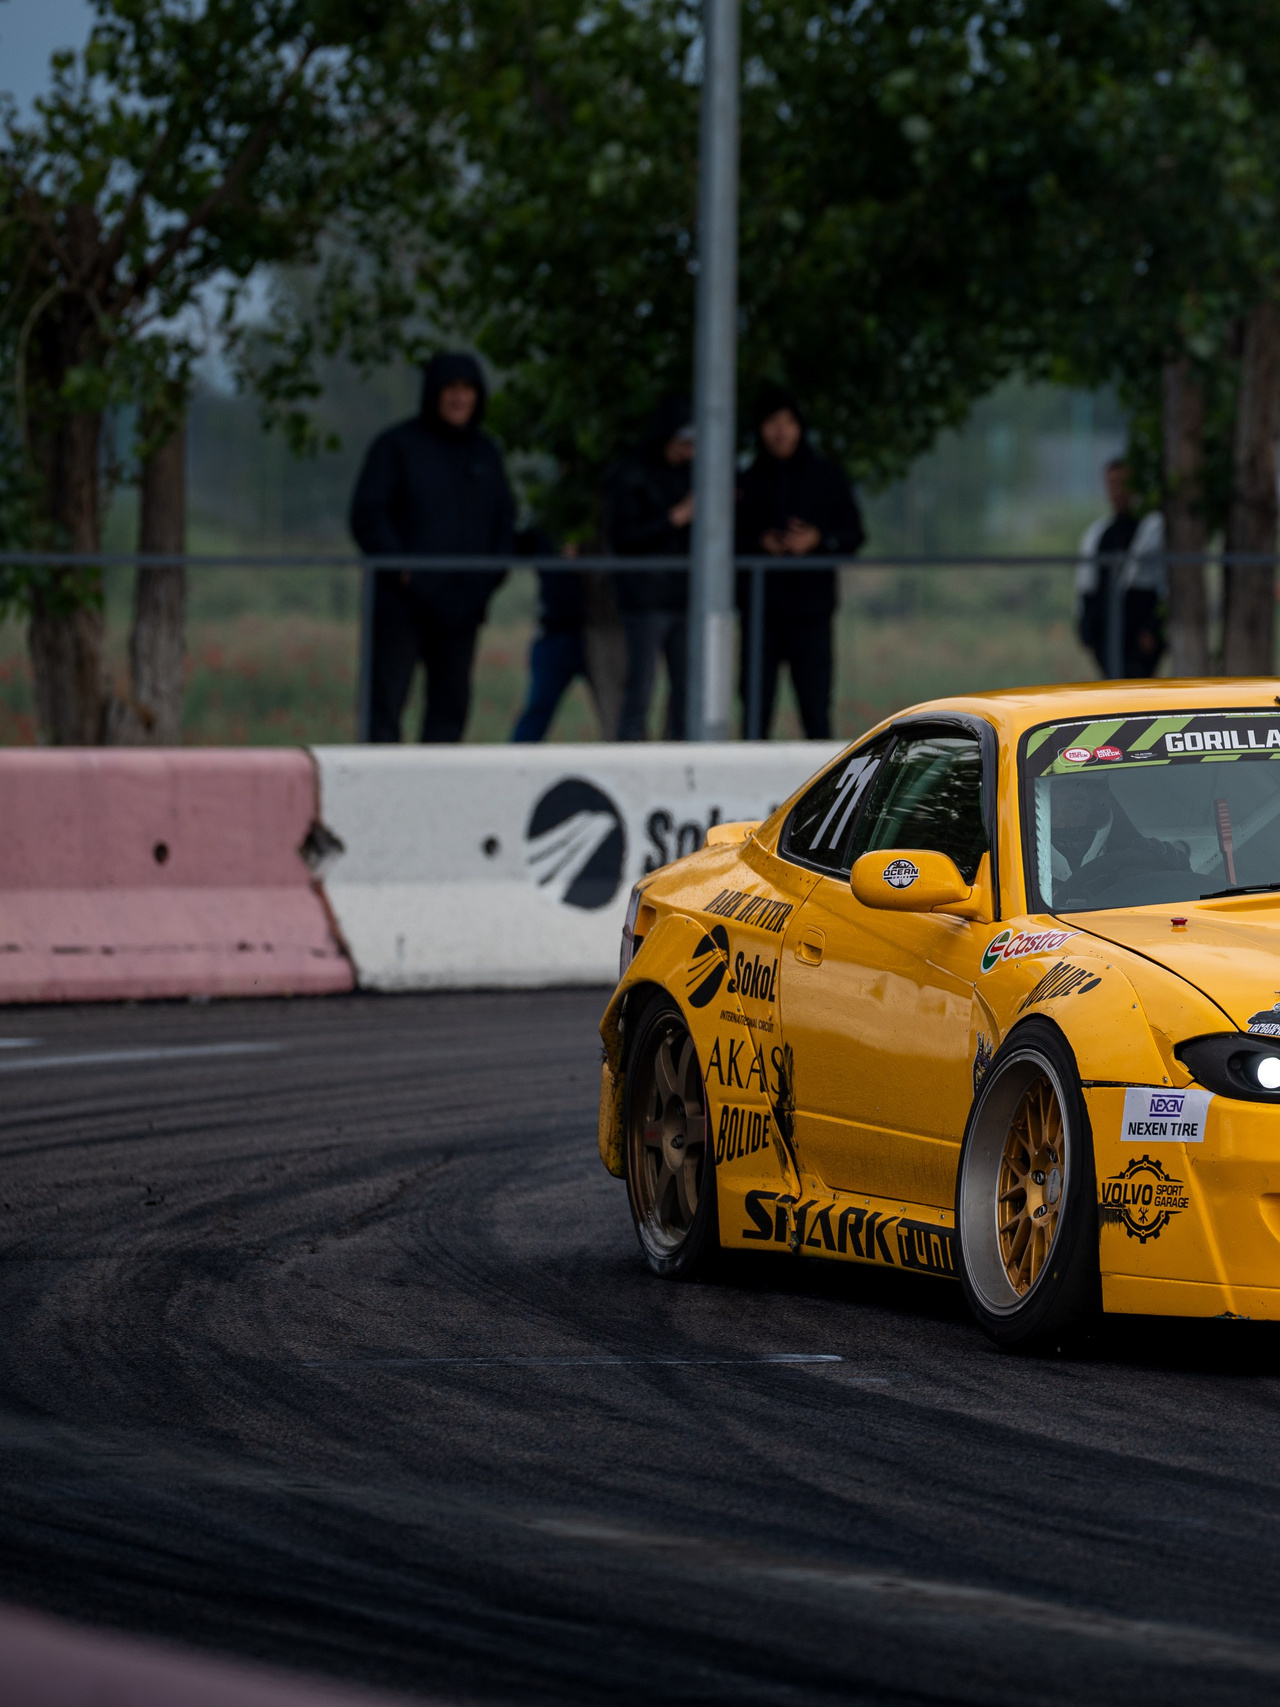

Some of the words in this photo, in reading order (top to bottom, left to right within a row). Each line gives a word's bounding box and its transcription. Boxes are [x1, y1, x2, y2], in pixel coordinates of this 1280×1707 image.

[809, 755, 881, 850] 71
[883, 868, 919, 877] OCEAN
[703, 889, 751, 918] DARK
[735, 896, 794, 934] HUNTER
[1003, 930, 1083, 958] Castrol
[719, 1010, 758, 1030] INTERNATIONAL
[758, 1019, 775, 1033] CIRCUIT
[705, 1036, 784, 1095] AKAS
[1150, 1098, 1184, 1113] NEXEN
[715, 1104, 771, 1166] BOLIDE
[1128, 1122, 1167, 1136] NEXEN
[1170, 1122, 1198, 1136] TIRE
[1101, 1182, 1153, 1206] VOLVO
[1156, 1184, 1184, 1196] SPORT
[1154, 1196, 1189, 1209] GARAGE
[742, 1189, 900, 1265] SHARK
